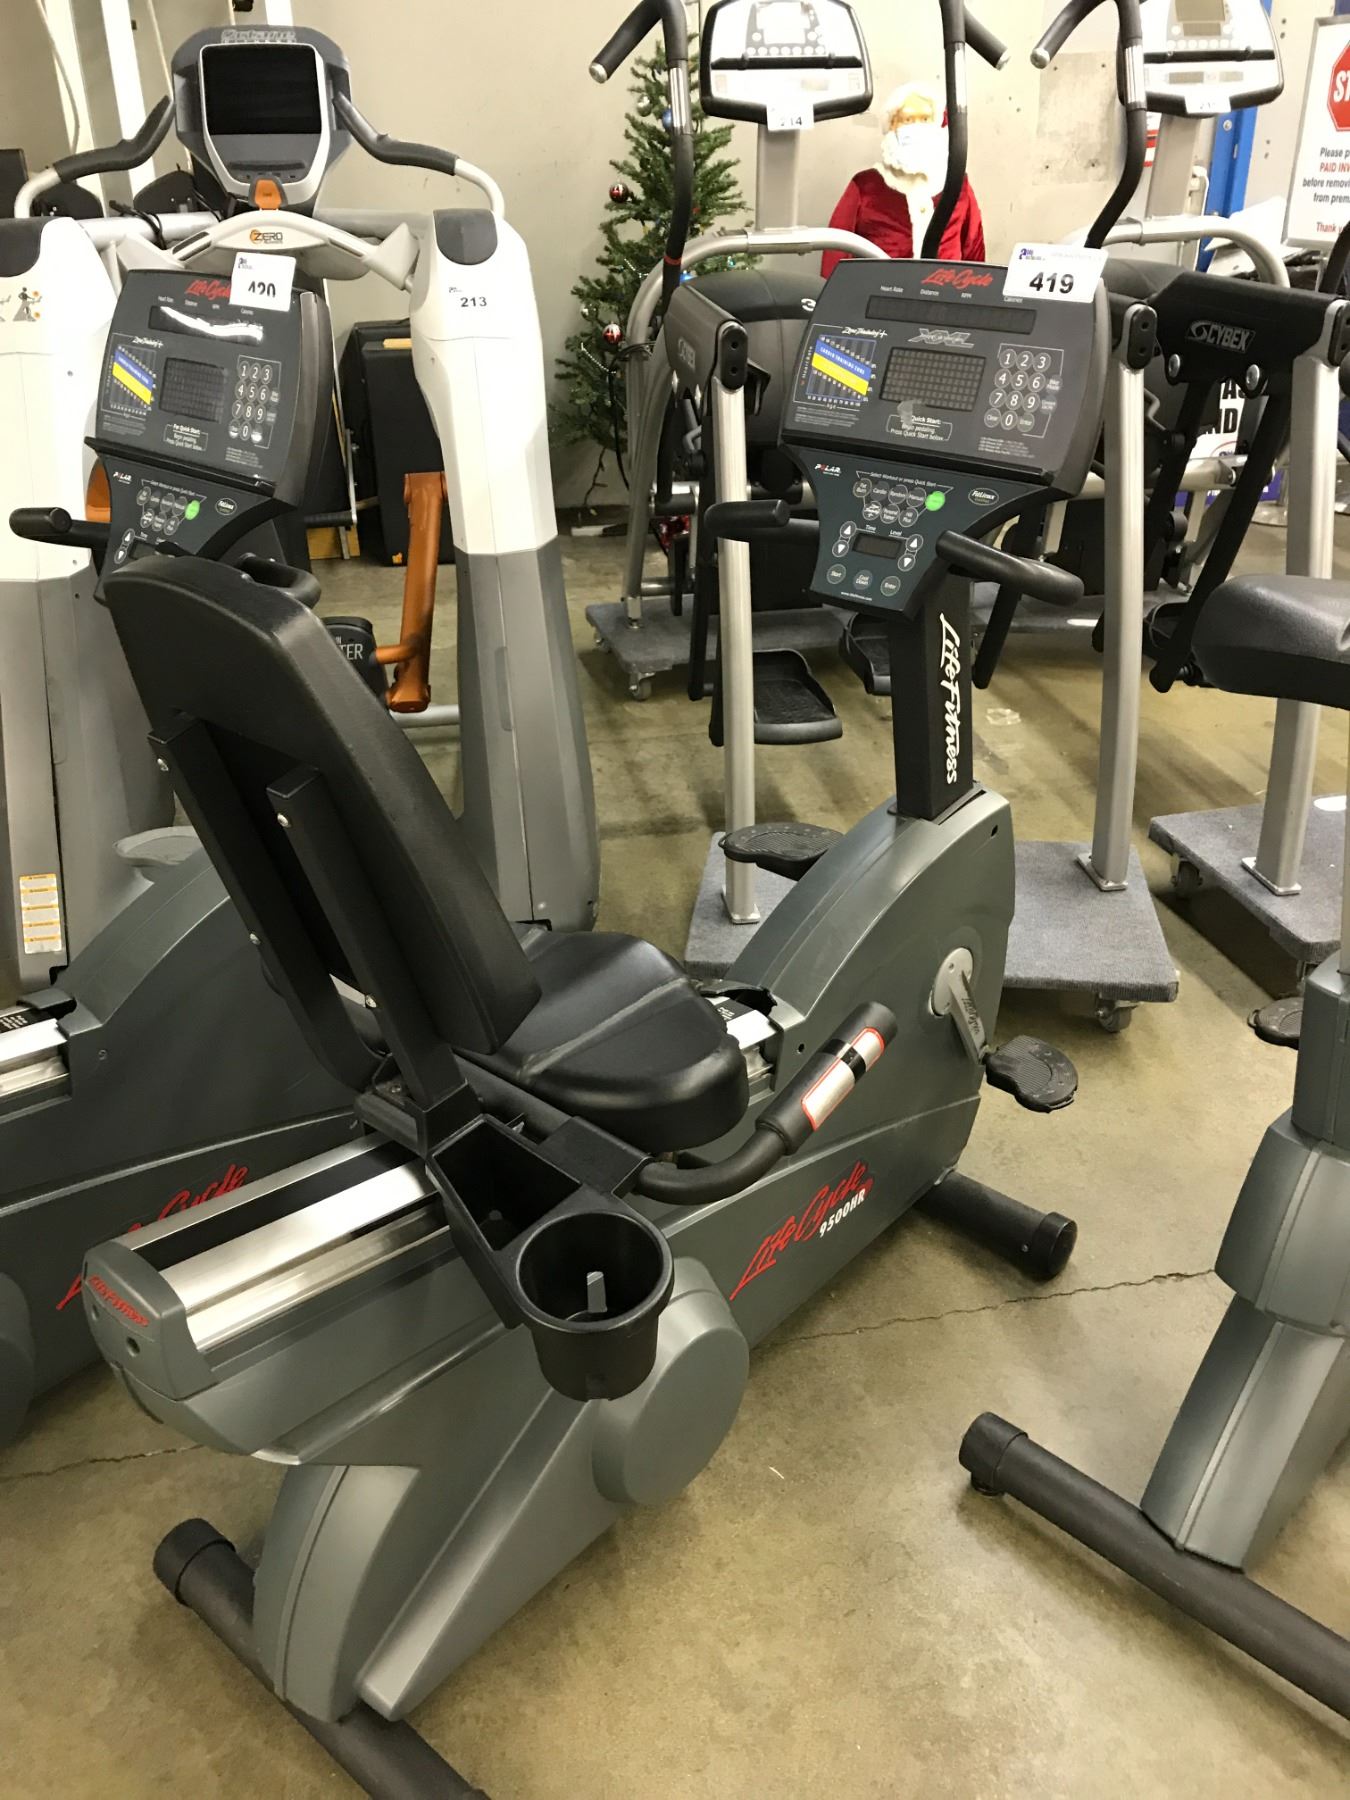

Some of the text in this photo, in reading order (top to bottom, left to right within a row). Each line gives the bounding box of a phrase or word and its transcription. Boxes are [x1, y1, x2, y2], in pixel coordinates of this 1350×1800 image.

[1320, 147, 1343, 158] Please
[1320, 162, 1337, 173] PAID
[1303, 177, 1324, 188] before
[1316, 221, 1337, 233] Thank
[1029, 271, 1075, 294] 419
[460, 296, 487, 308] 213
[1204, 323, 1251, 352] CYBEX
[1005, 353, 1046, 369] 1 2 3
[241, 365, 270, 381] 1 2 3
[998, 372, 1006, 385] 4
[1015, 374, 1024, 387] 5
[1032, 376, 1041, 389] 6
[237, 384, 267, 400] 4 5 6
[994, 392, 1002, 404] 7
[1010, 394, 1018, 406] 8
[1027, 396, 1035, 408] 9
[235, 403, 263, 420] 7 8 9
[1005, 414, 1013, 426] 0
[819, 1188, 866, 1238] 9500HR
